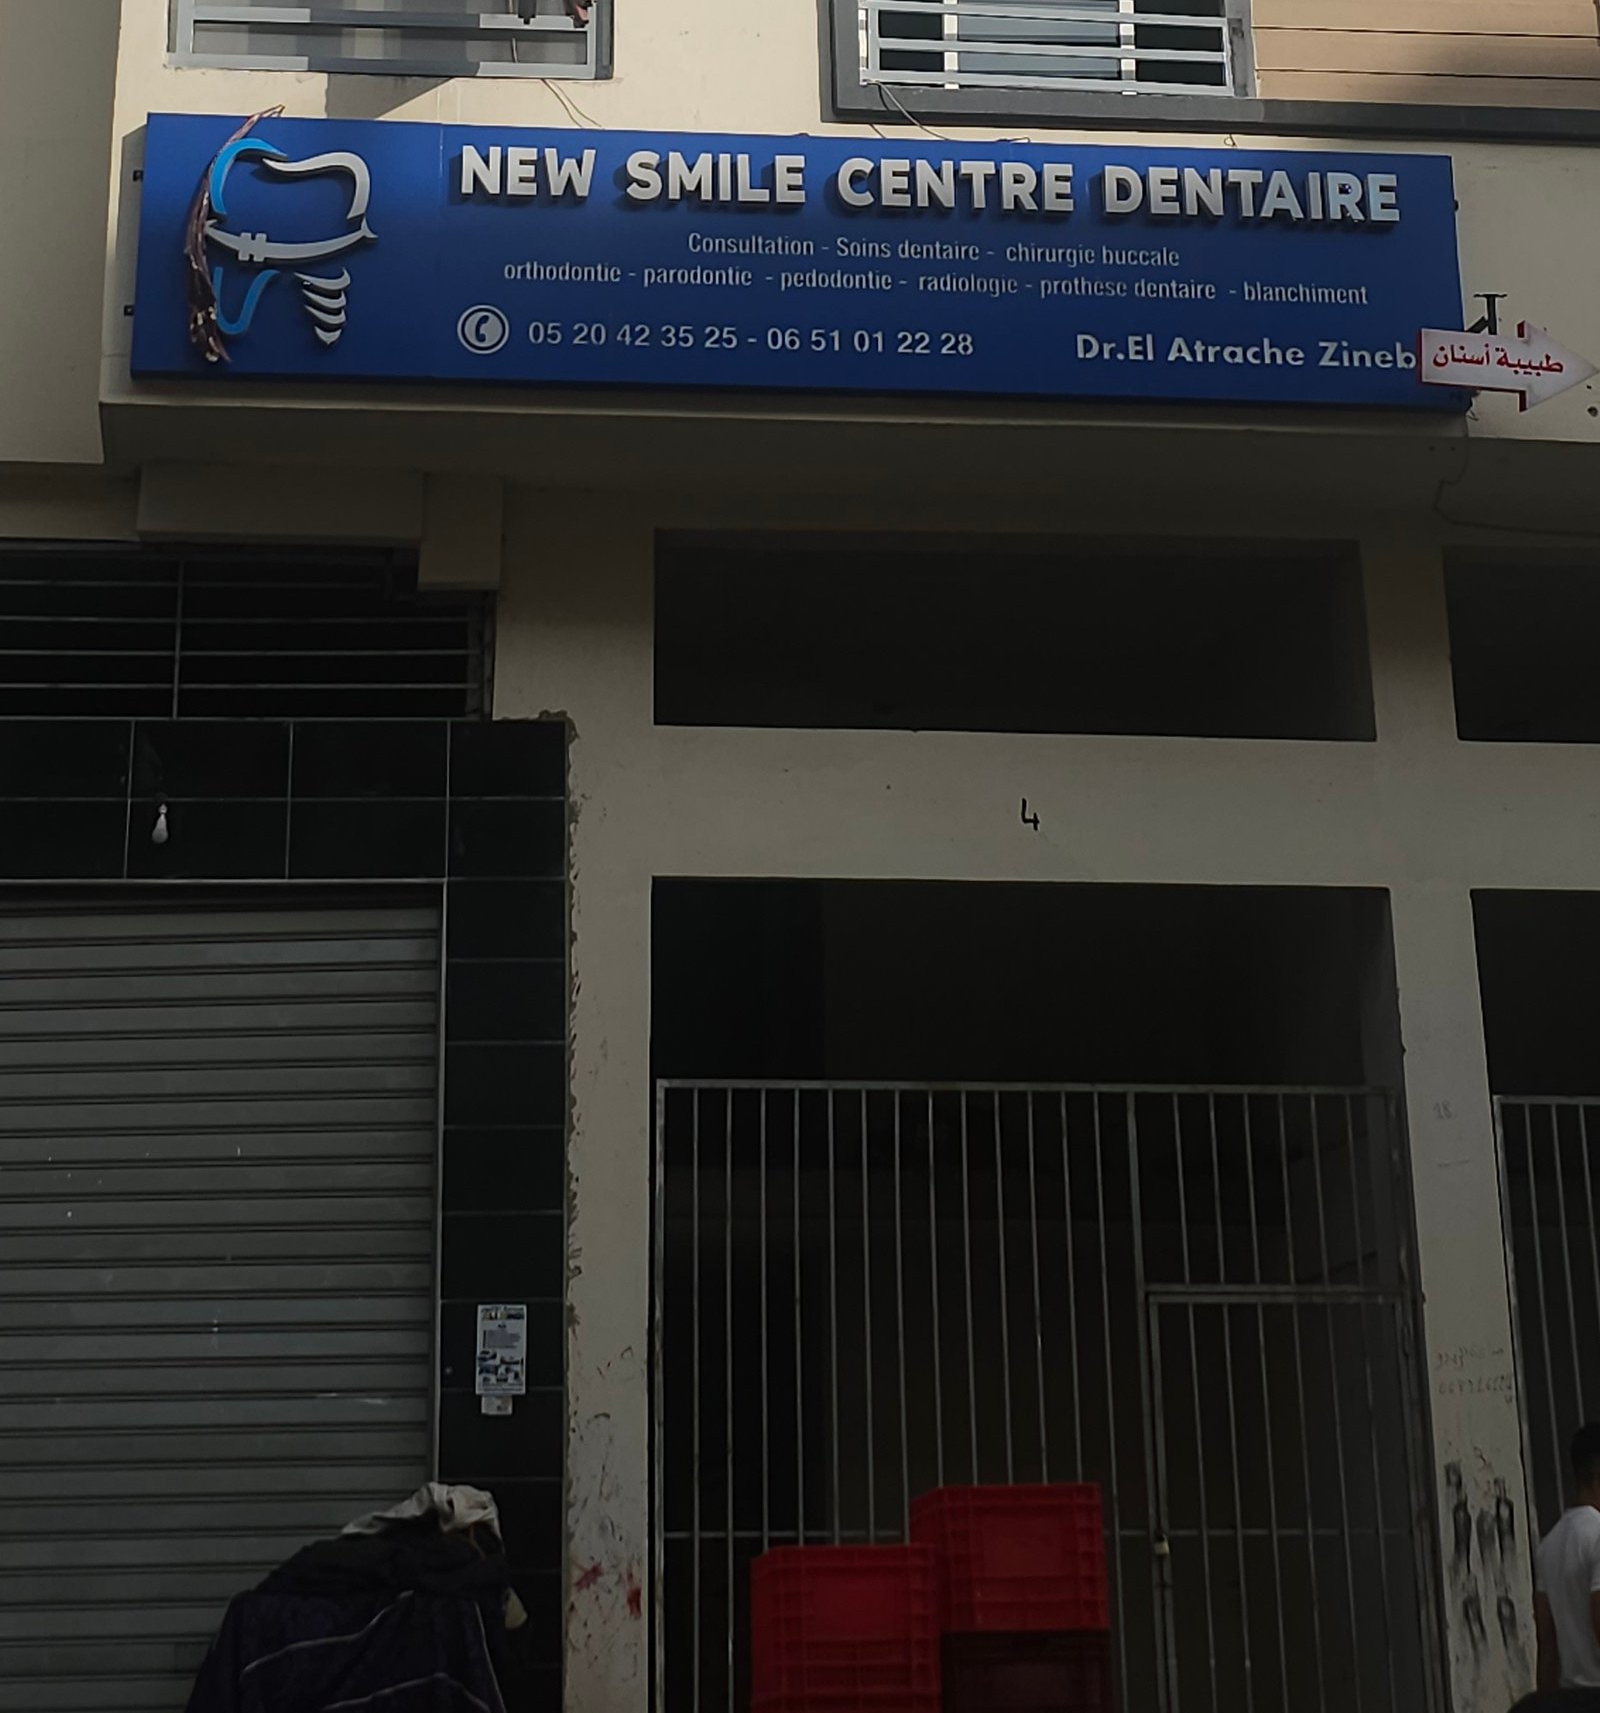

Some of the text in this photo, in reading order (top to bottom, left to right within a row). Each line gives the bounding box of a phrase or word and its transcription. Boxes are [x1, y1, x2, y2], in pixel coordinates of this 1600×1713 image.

[461, 145, 1400, 222] NEW SMILE CENTRE DENTAIRE
[688, 232, 815, 255] Consultation
[836, 236, 891, 258] Soins
[898, 240, 980, 261] dentaire
[1005, 242, 1096, 268] chirurgie
[503, 260, 621, 283] orthodontie
[643, 265, 752, 288] parodontie
[780, 268, 892, 292] pedodontie
[918, 273, 1018, 298] radiologie
[1134, 279, 1216, 300] dentaire
[1243, 281, 1369, 305] blanchiment
[528, 321, 563, 345] 05
[572, 323, 606, 346] 20
[616, 324, 651, 347] 42
[660, 324, 695, 348] 35
[704, 326, 738, 349] 25
[767, 328, 801, 350] 06
[810, 329, 841, 352] 51
[853, 330, 884, 353] 01
[896, 331, 931, 354] 22
[940, 333, 974, 356] 28
[1166, 336, 1306, 366] Atrache
[1318, 340, 1417, 370] Zineb
[1432, 343, 1564, 377] طبيبة أسنان
[1020, 797, 1040, 832] 4
